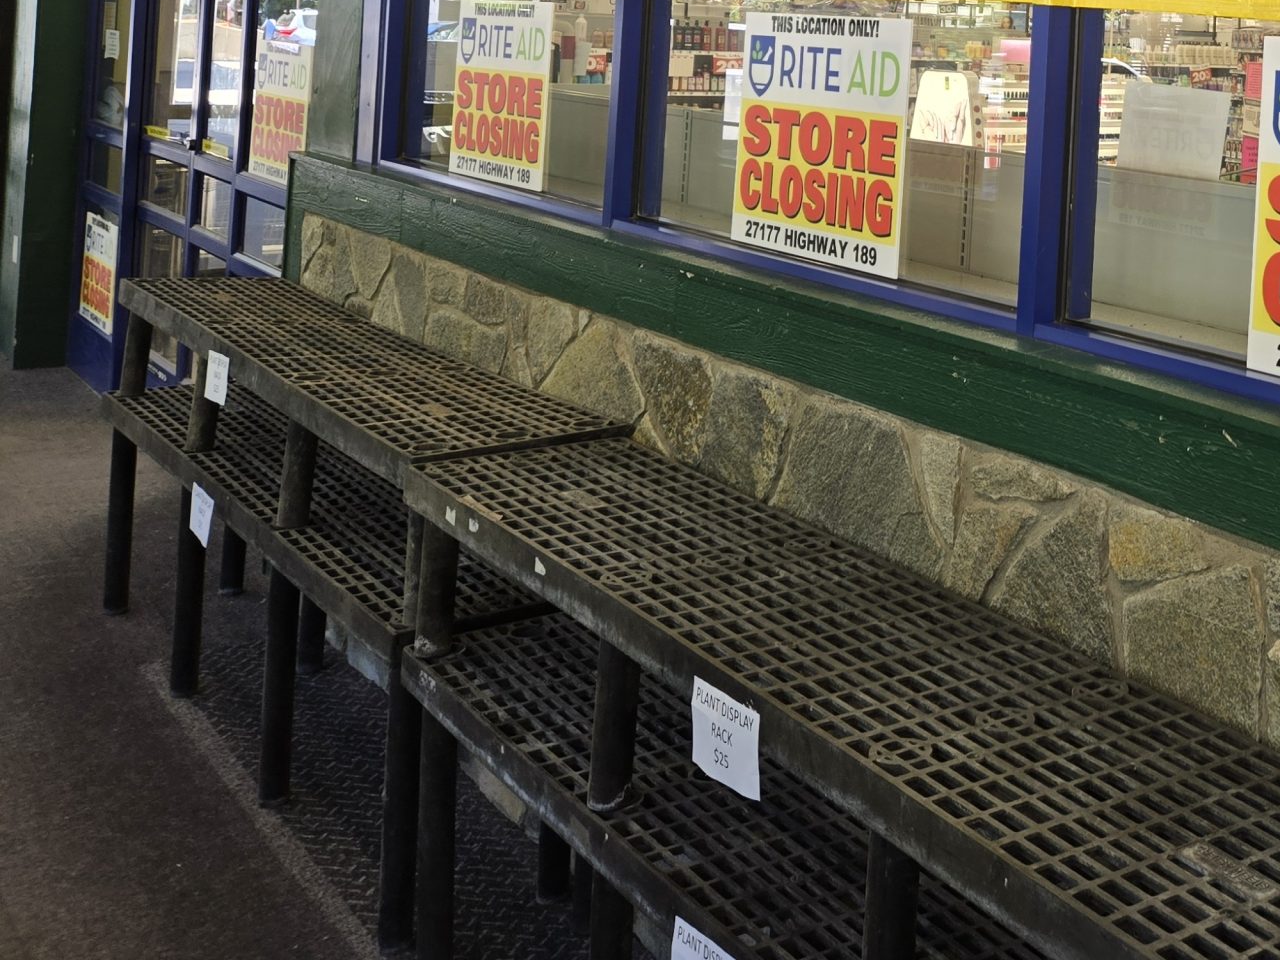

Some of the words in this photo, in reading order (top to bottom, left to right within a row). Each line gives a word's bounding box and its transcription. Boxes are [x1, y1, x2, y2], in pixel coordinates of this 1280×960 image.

[488, 3, 516, 17] LOCATION
[772, 16, 793, 33] THIS
[796, 16, 846, 36] LOCATION
[848, 19, 879, 38] ONLY!
[478, 24, 514, 59] RITE
[516, 27, 545, 61] AID
[268, 59, 289, 87] RITE
[290, 63, 307, 90] AID
[780, 44, 842, 93] RITE
[847, 50, 900, 97] AID
[457, 69, 543, 119] STORE
[254, 94, 305, 135] STORE
[454, 110, 540, 164] CLOSING
[743, 104, 898, 177] STORE
[456, 155, 477, 173] 27177
[479, 159, 514, 180] HIGHWAY
[516, 167, 531, 184] 189
[740, 158, 893, 238] CLOSING
[745, 220, 781, 243] 27177
[784, 227, 848, 259] HIGHWAY
[853, 243, 877, 266] 189
[697, 686, 720, 712] PLANT
[721, 702, 755, 732] DISPLAY
[711, 722, 733, 747] RACK
[713, 748, 729, 768] $25
[677, 926, 702, 955] PLANT
